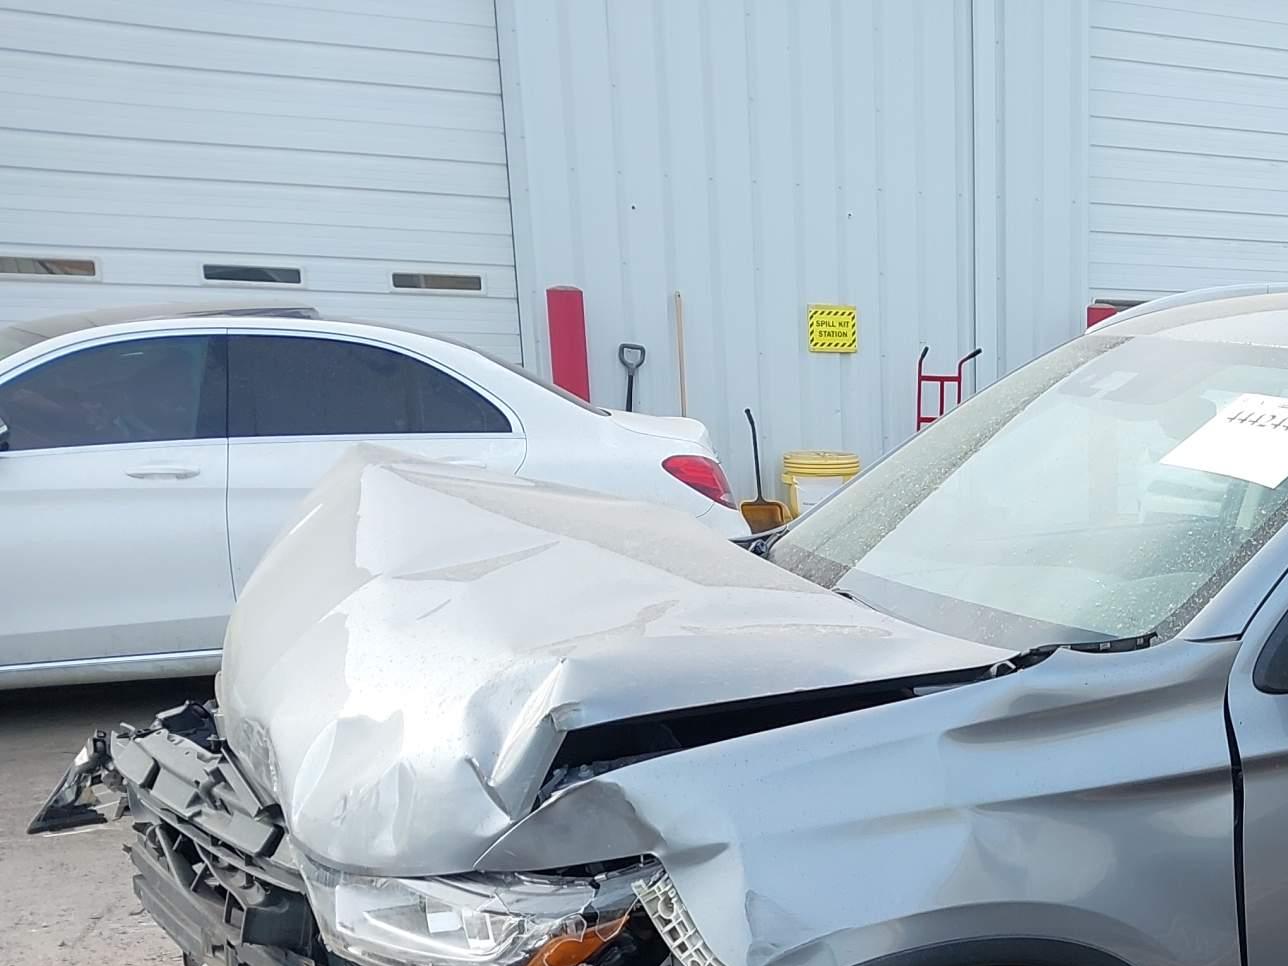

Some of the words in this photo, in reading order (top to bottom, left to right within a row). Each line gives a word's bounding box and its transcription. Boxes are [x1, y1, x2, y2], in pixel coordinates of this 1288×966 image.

[815, 320, 836, 328] SPILL
[838, 320, 850, 328] KIT
[818, 330, 848, 338] STATION
